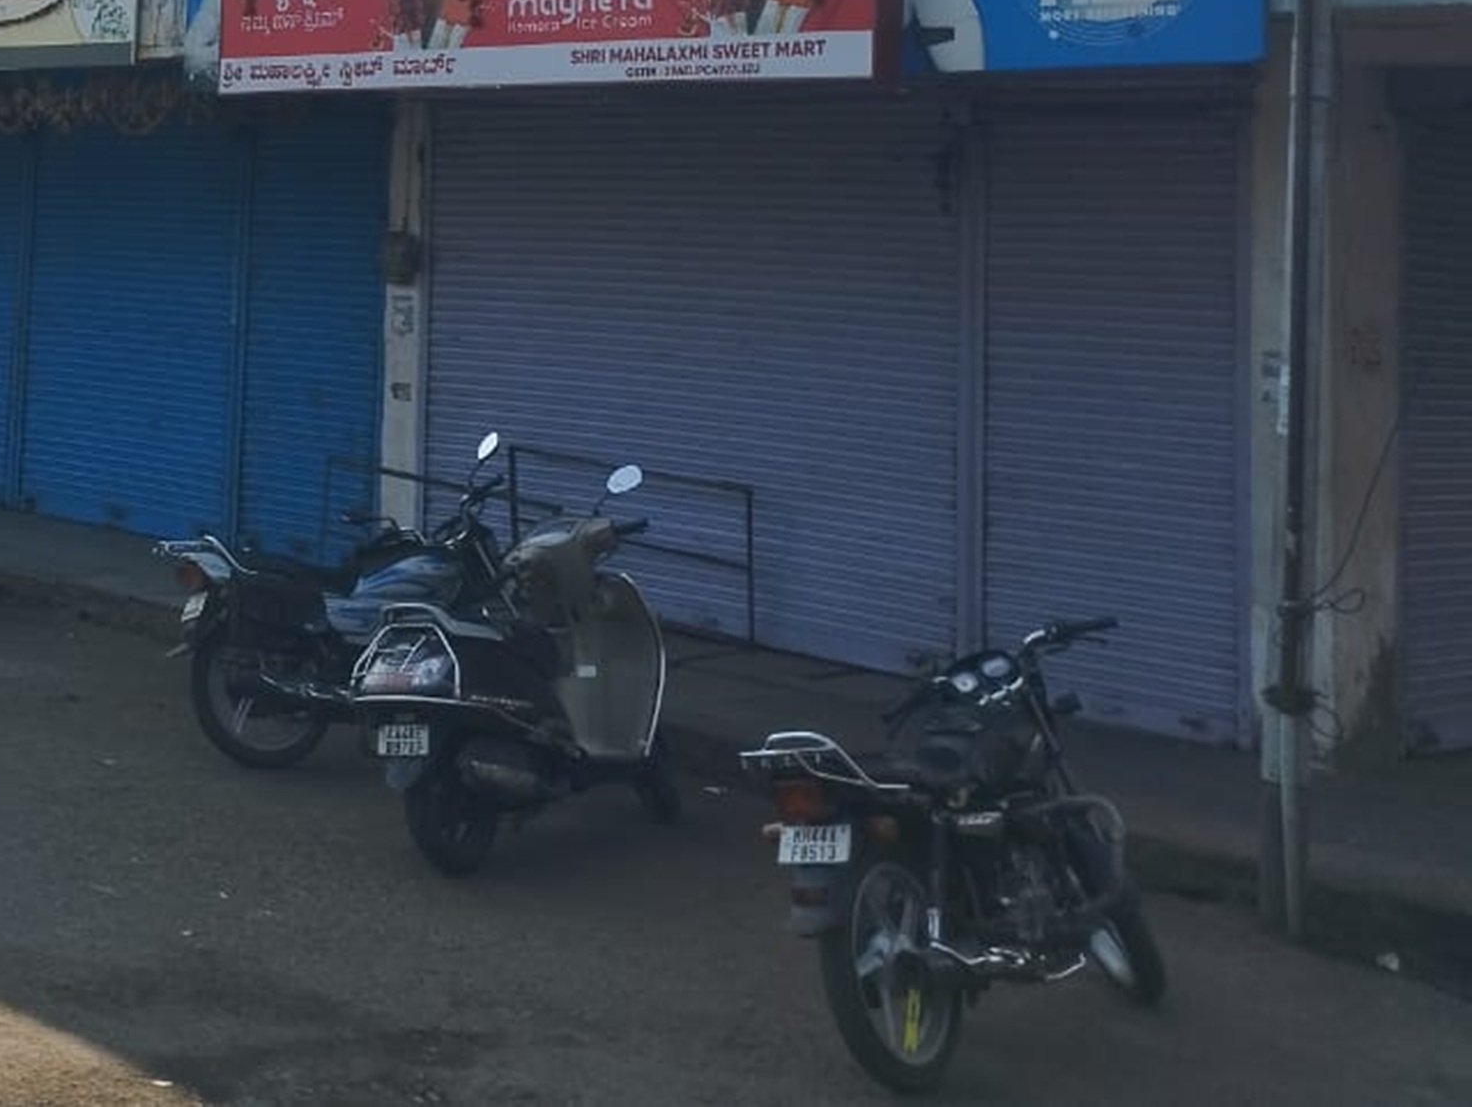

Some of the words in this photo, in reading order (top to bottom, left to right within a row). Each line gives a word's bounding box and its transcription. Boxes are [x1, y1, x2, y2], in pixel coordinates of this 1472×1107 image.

[602, 12, 653, 31] Cream
[570, 48, 607, 66] SHRI
[609, 44, 709, 64] MAHALAXMI
[712, 40, 773, 61] SWEET
[775, 38, 827, 58] MART
[222, 62, 243, 89] ಶ್ರೀ
